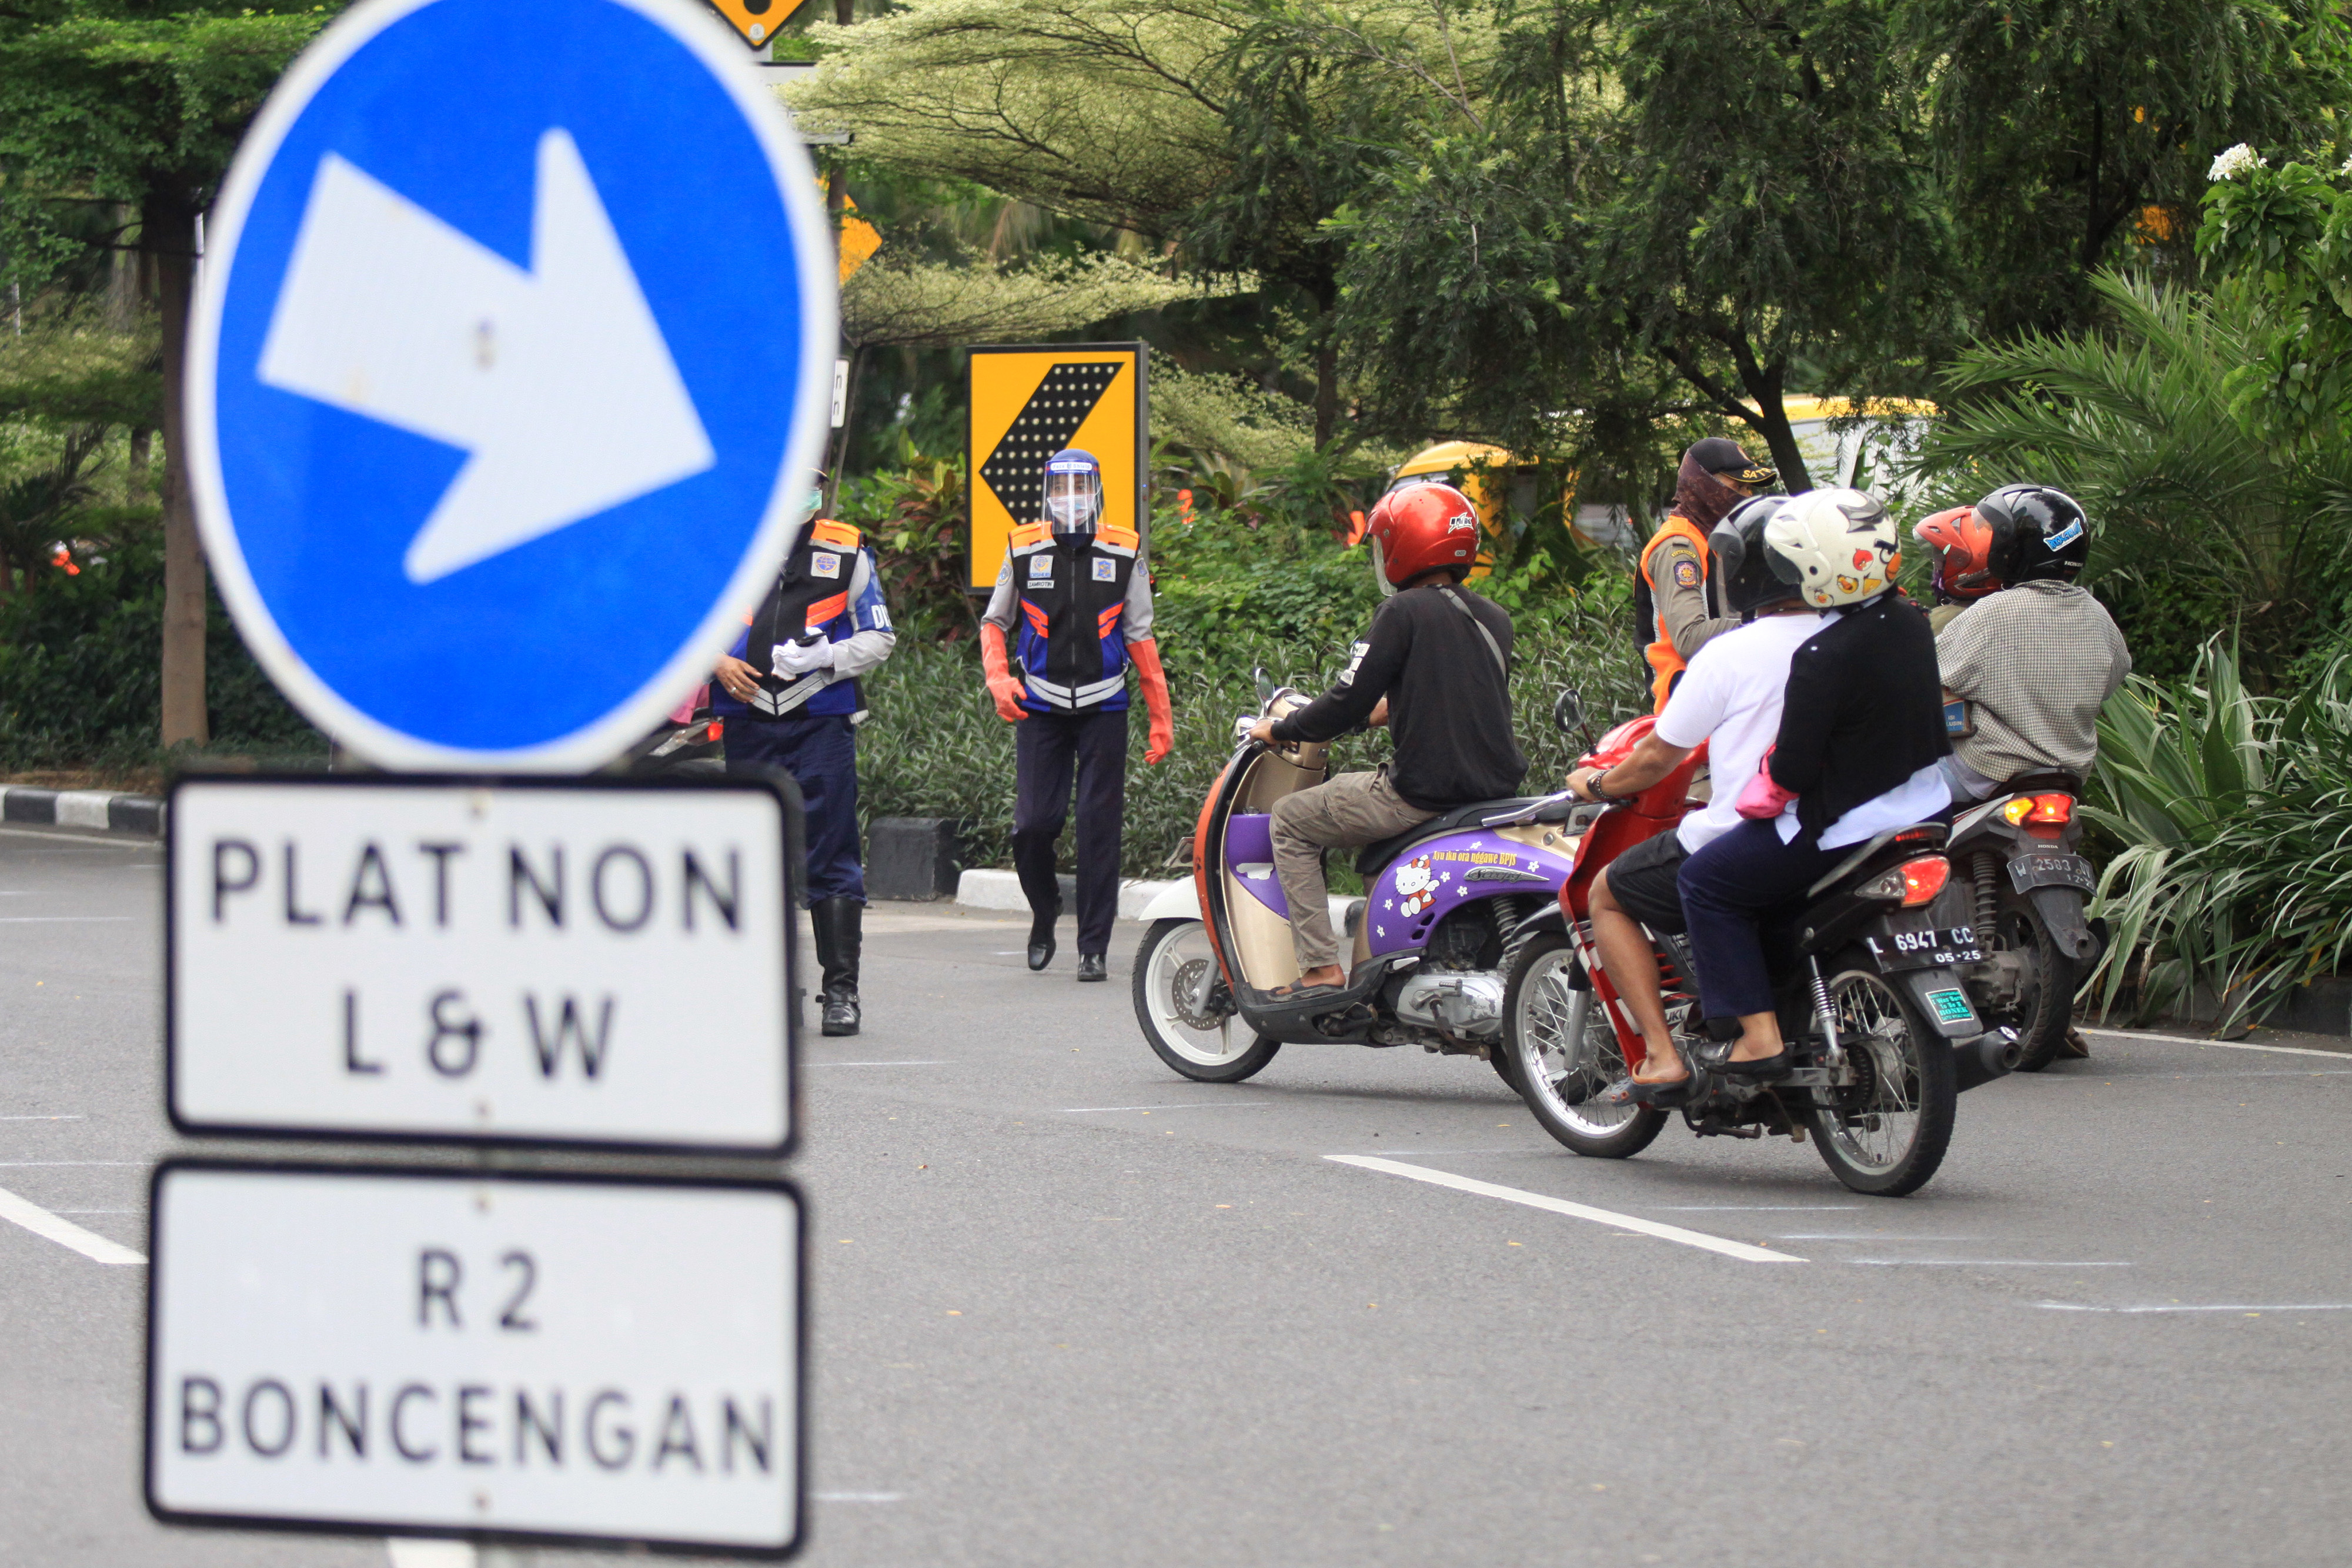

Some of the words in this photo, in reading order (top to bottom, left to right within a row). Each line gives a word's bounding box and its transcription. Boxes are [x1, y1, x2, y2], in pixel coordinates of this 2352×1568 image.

[1432, 850, 1445, 861] Ayu
[1445, 851, 1456, 861] iku
[1458, 853, 1469, 862] ora
[1471, 854, 1498, 864] nggawe
[1499, 852, 1517, 867] BPJS
[2014, 862, 2026, 877] W
[2036, 858, 2071, 872] 2583
[212, 839, 463, 925] PLAT
[508, 845, 740, 932] NON
[1866, 937, 1884, 954] L
[1895, 930, 1937, 951] 6947
[1951, 927, 1974, 944] CC
[345, 992, 381, 1074] L
[427, 991, 483, 1078] &
[525, 997, 612, 1080] W
[1939, 1006, 1969, 1017] BONEK
[420, 1250, 459, 1323] R
[500, 1253, 533, 1329] 2
[181, 1378, 769, 1472] BONCENGAN
